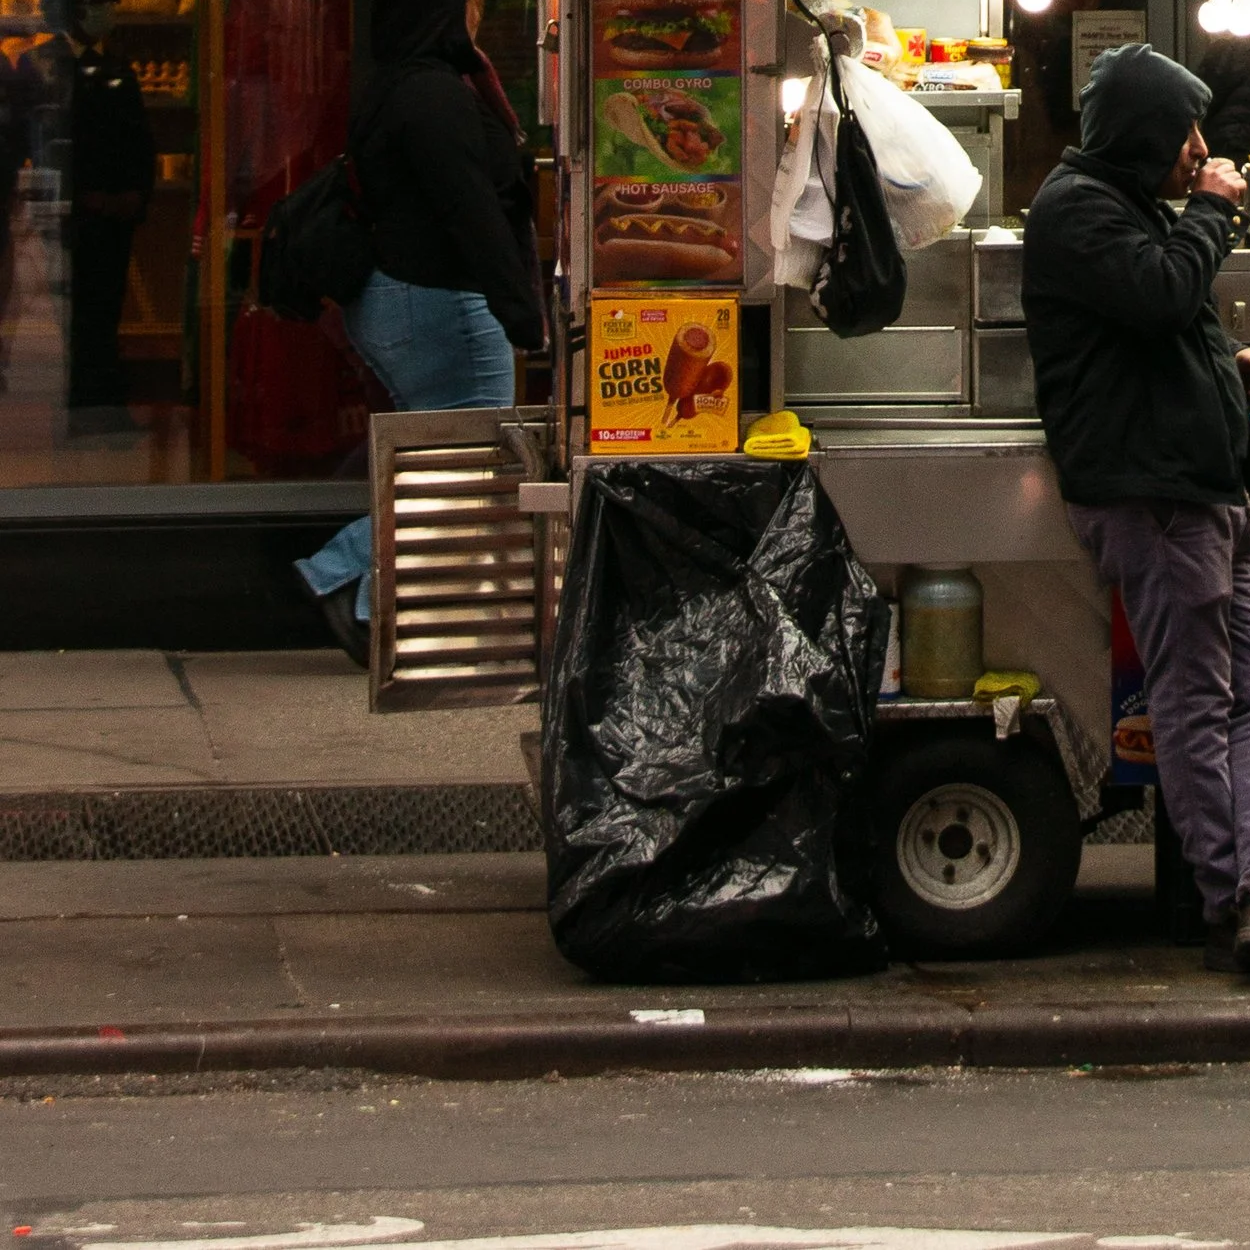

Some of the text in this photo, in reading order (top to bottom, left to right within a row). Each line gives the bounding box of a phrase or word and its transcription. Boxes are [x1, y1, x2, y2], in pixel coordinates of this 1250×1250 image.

[622, 78, 713, 90] COMBO GYRO
[620, 182, 716, 195] HOT SAUSAGE
[716, 308, 730, 321] 28
[603, 343, 653, 361] JUMBO
[598, 357, 662, 381] CORN
[600, 376, 663, 400] DOGS
